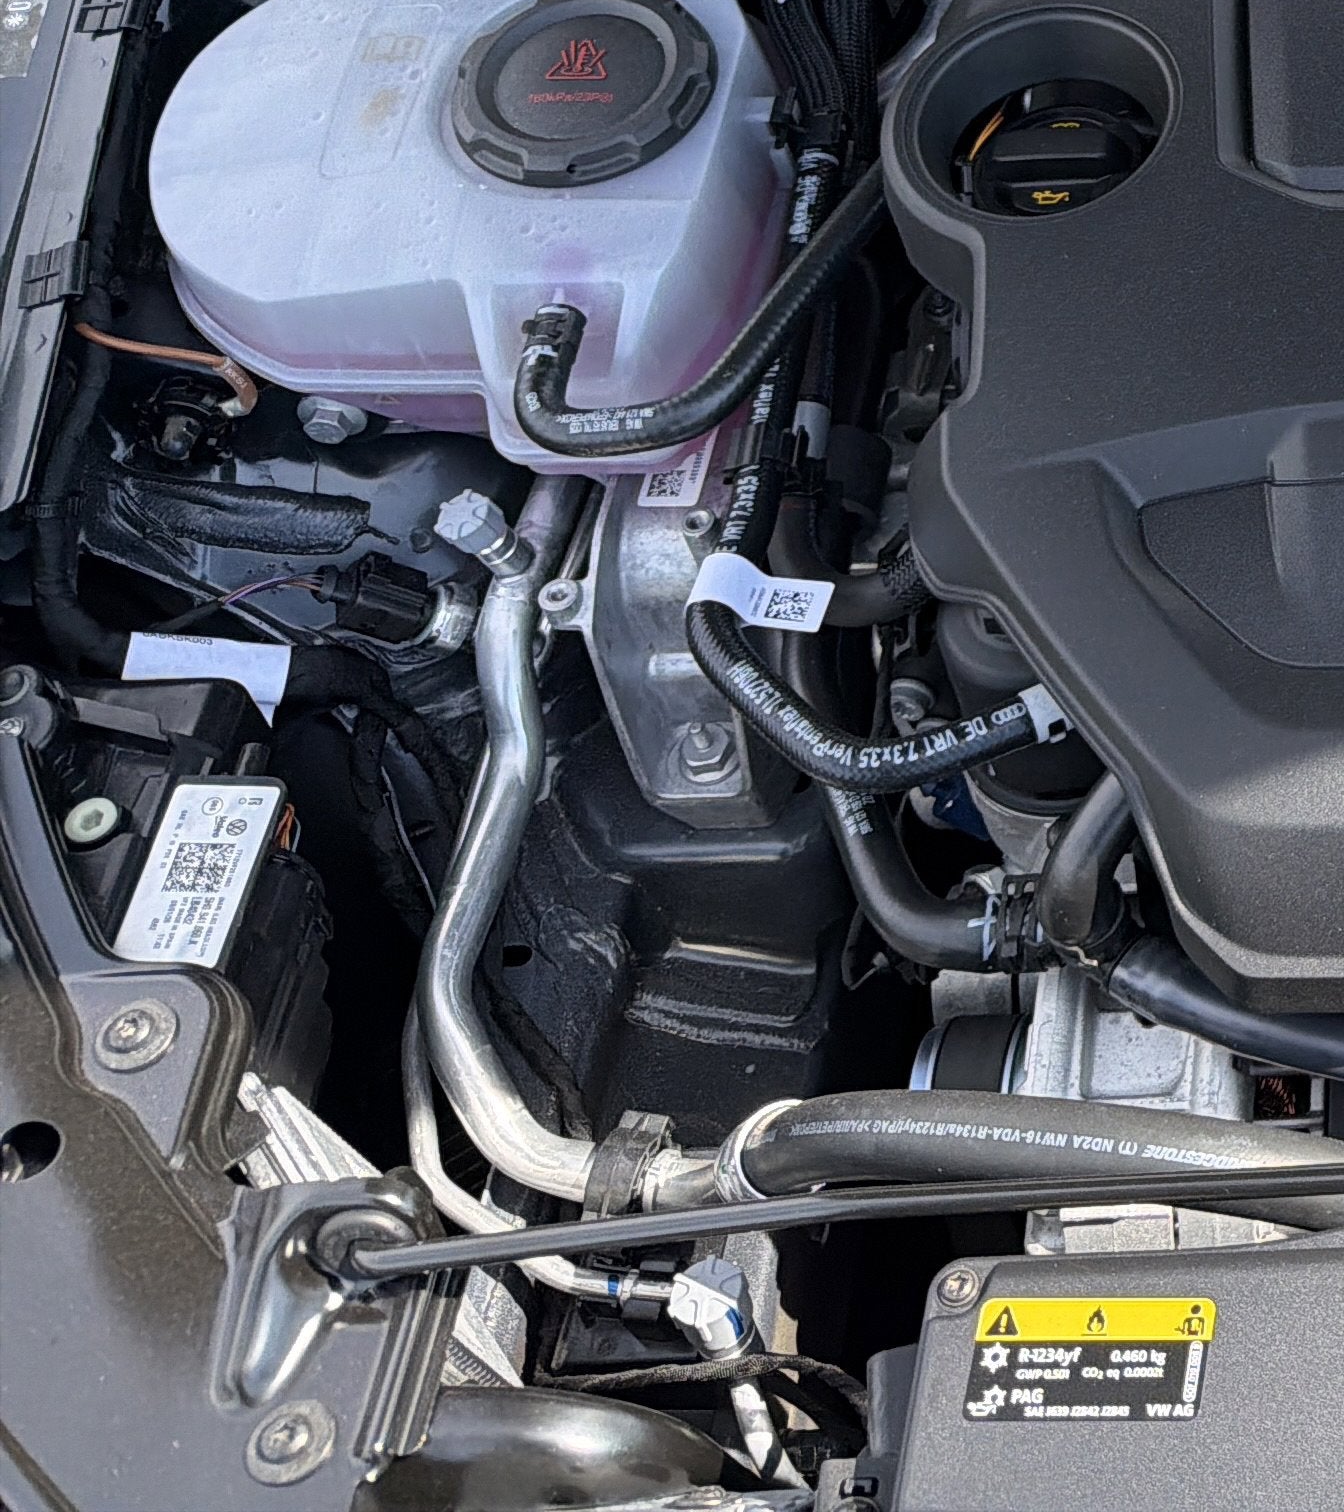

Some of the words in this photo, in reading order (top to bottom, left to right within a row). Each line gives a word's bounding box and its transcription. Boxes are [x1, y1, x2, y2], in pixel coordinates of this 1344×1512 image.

[958, 715, 988, 741] DE
[920, 727, 958, 757] VRT
[1070, 1134, 1114, 1152] ND2A
[1018, 1347, 1082, 1364] R-1234yf
[1110, 1349, 1148, 1363] 0.460
[1150, 1349, 1167, 1364] kg
[1015, 1368, 1043, 1380] GWP
[1106, 1368, 1120, 1381] eq
[1010, 1388, 1045, 1404] PAG
[1024, 1406, 1044, 1418] SAE
[1146, 1403, 1171, 1417] VW
[1172, 1403, 1194, 1417] AG
